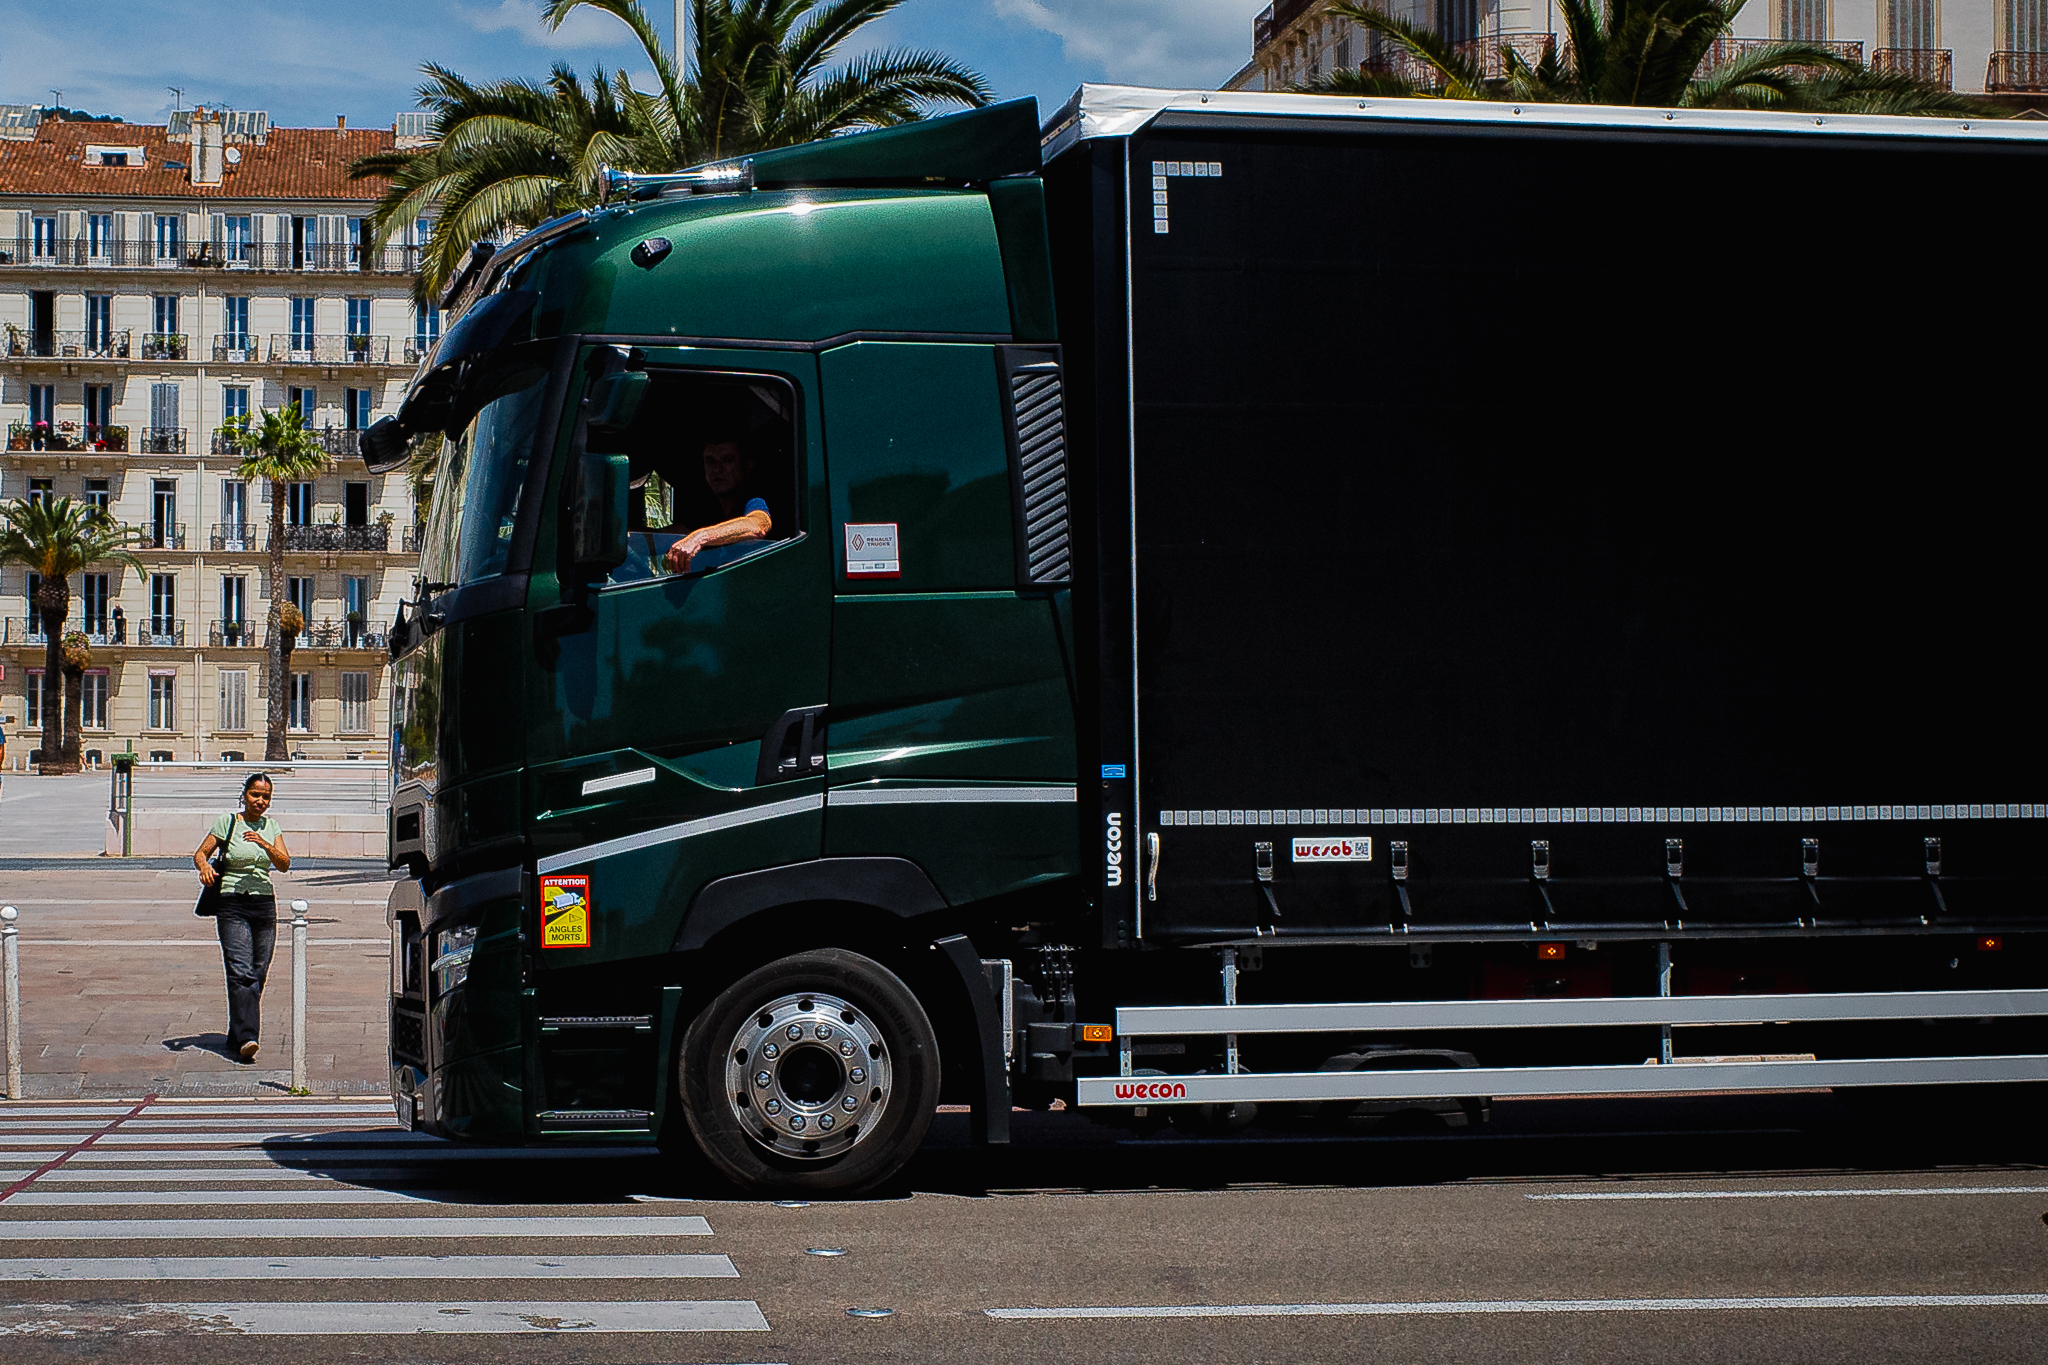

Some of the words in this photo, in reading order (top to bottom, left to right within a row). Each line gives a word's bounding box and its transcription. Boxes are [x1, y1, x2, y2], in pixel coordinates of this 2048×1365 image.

[1107, 812, 1122, 887] wecon
[1295, 840, 1353, 857] wesob
[549, 925, 583, 933] ANGLES
[551, 933, 581, 941] MORTS
[845, 970, 912, 1035] Continental
[1115, 1083, 1186, 1099] wecon
